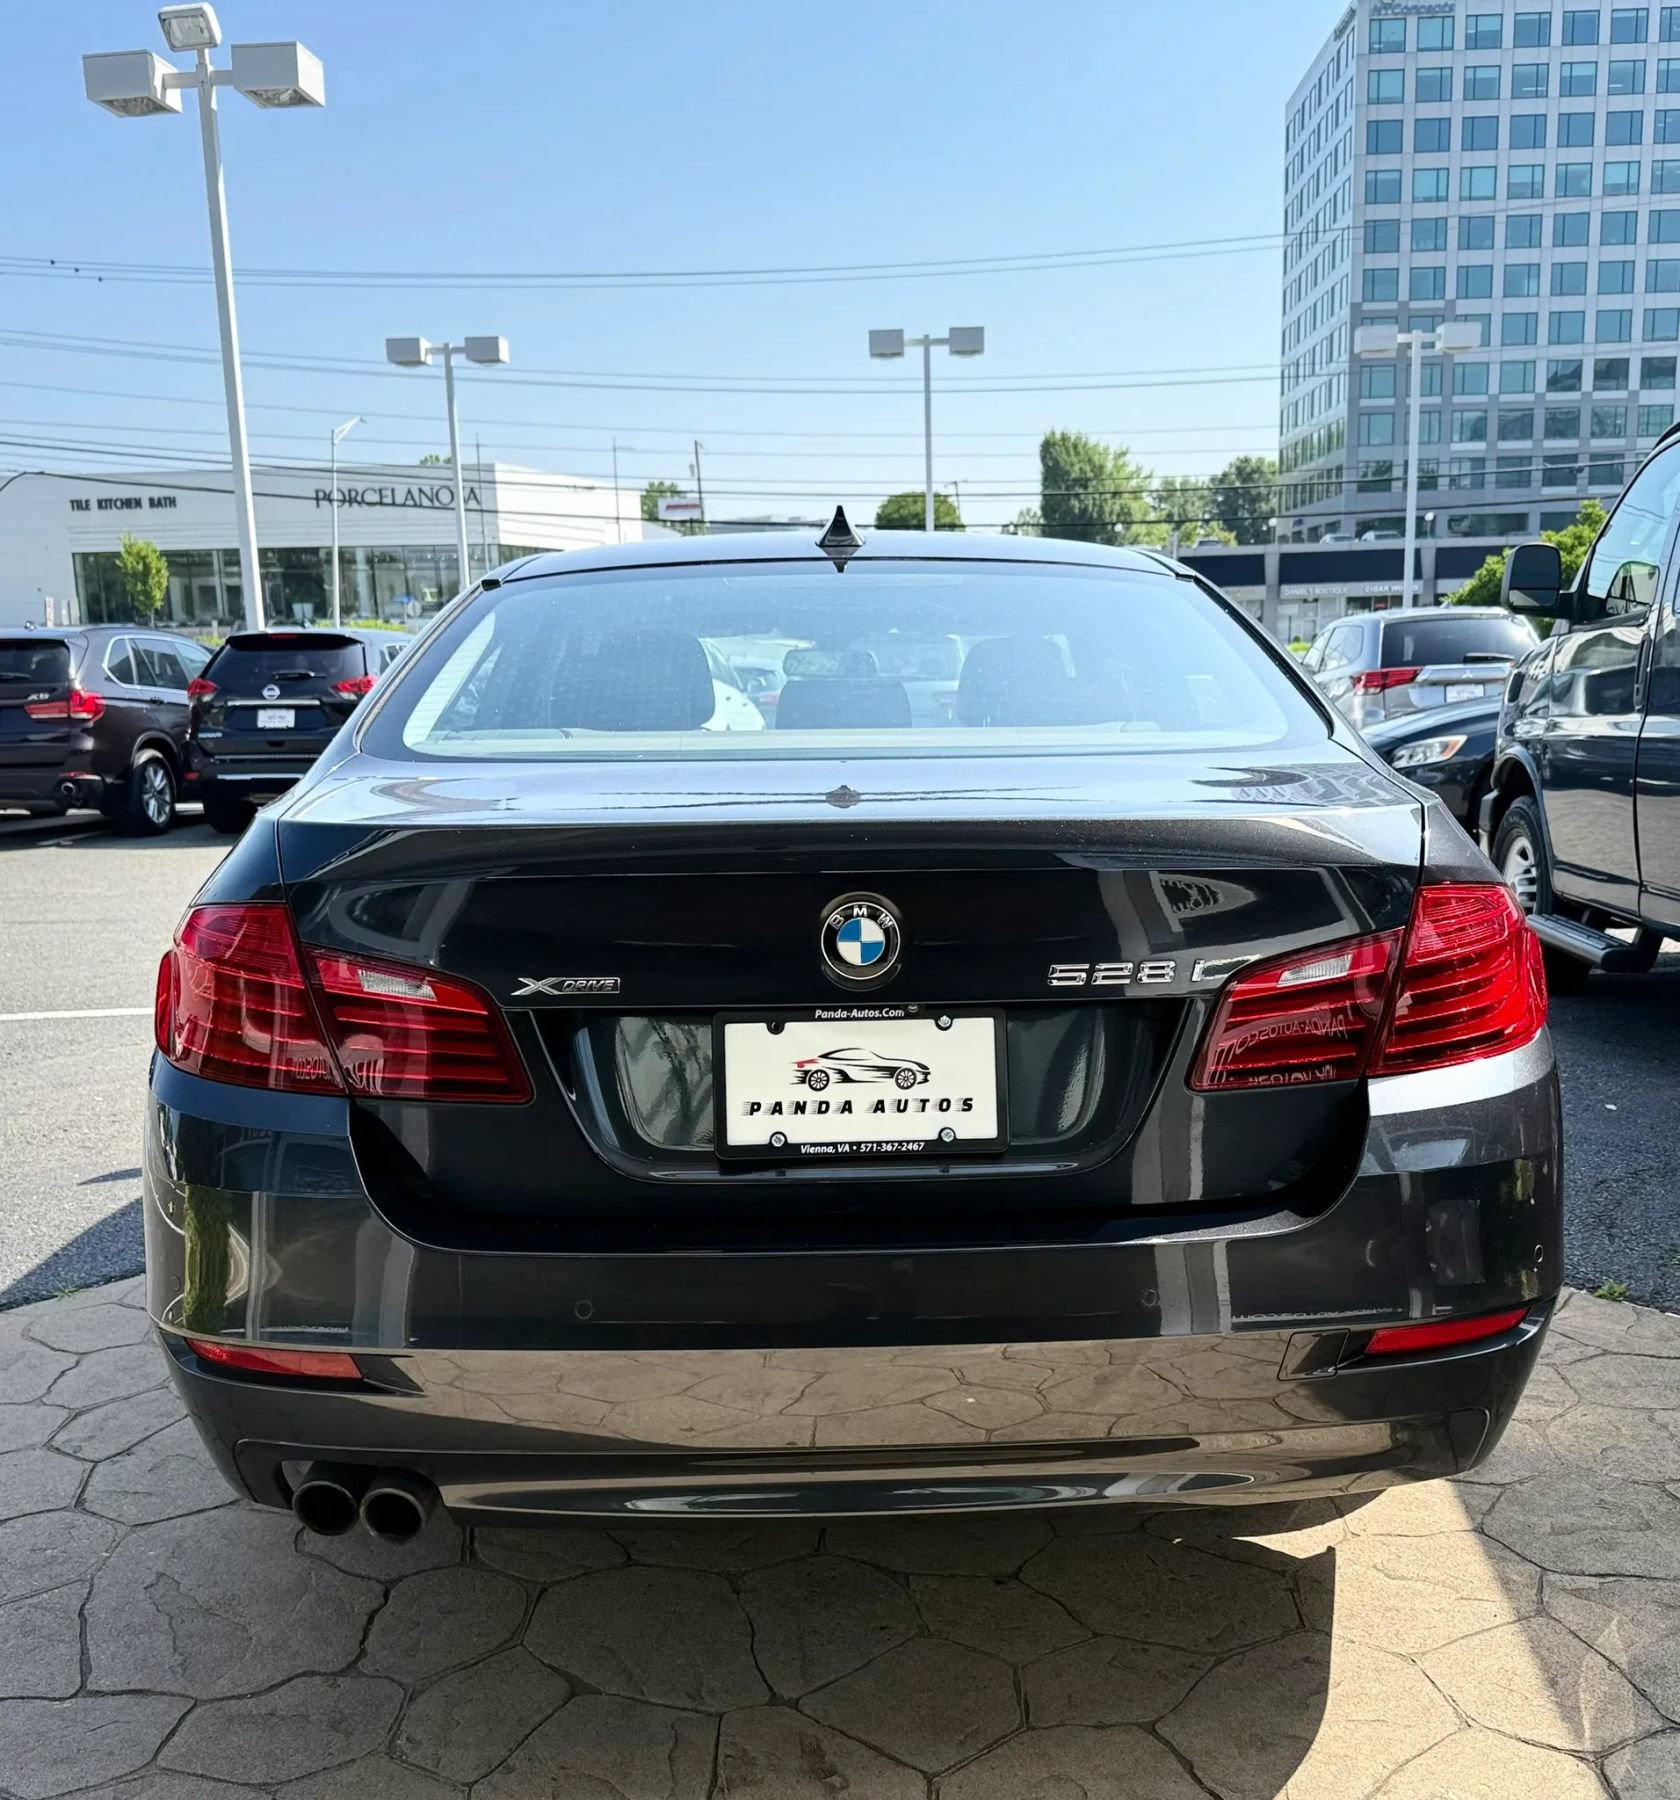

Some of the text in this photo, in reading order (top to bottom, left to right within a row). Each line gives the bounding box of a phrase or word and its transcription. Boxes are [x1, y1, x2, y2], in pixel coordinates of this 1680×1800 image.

[69, 496, 177, 512] TILE KITCHEN BATH
[314, 486, 482, 508] PORCELANOA
[828, 904, 894, 930] BMW
[815, 1008, 905, 1019] Panda-Autos.Com
[741, 1098, 973, 1116] PANDA AUTOS
[800, 1142, 925, 1154] Vienna, VA 571-367-2467
